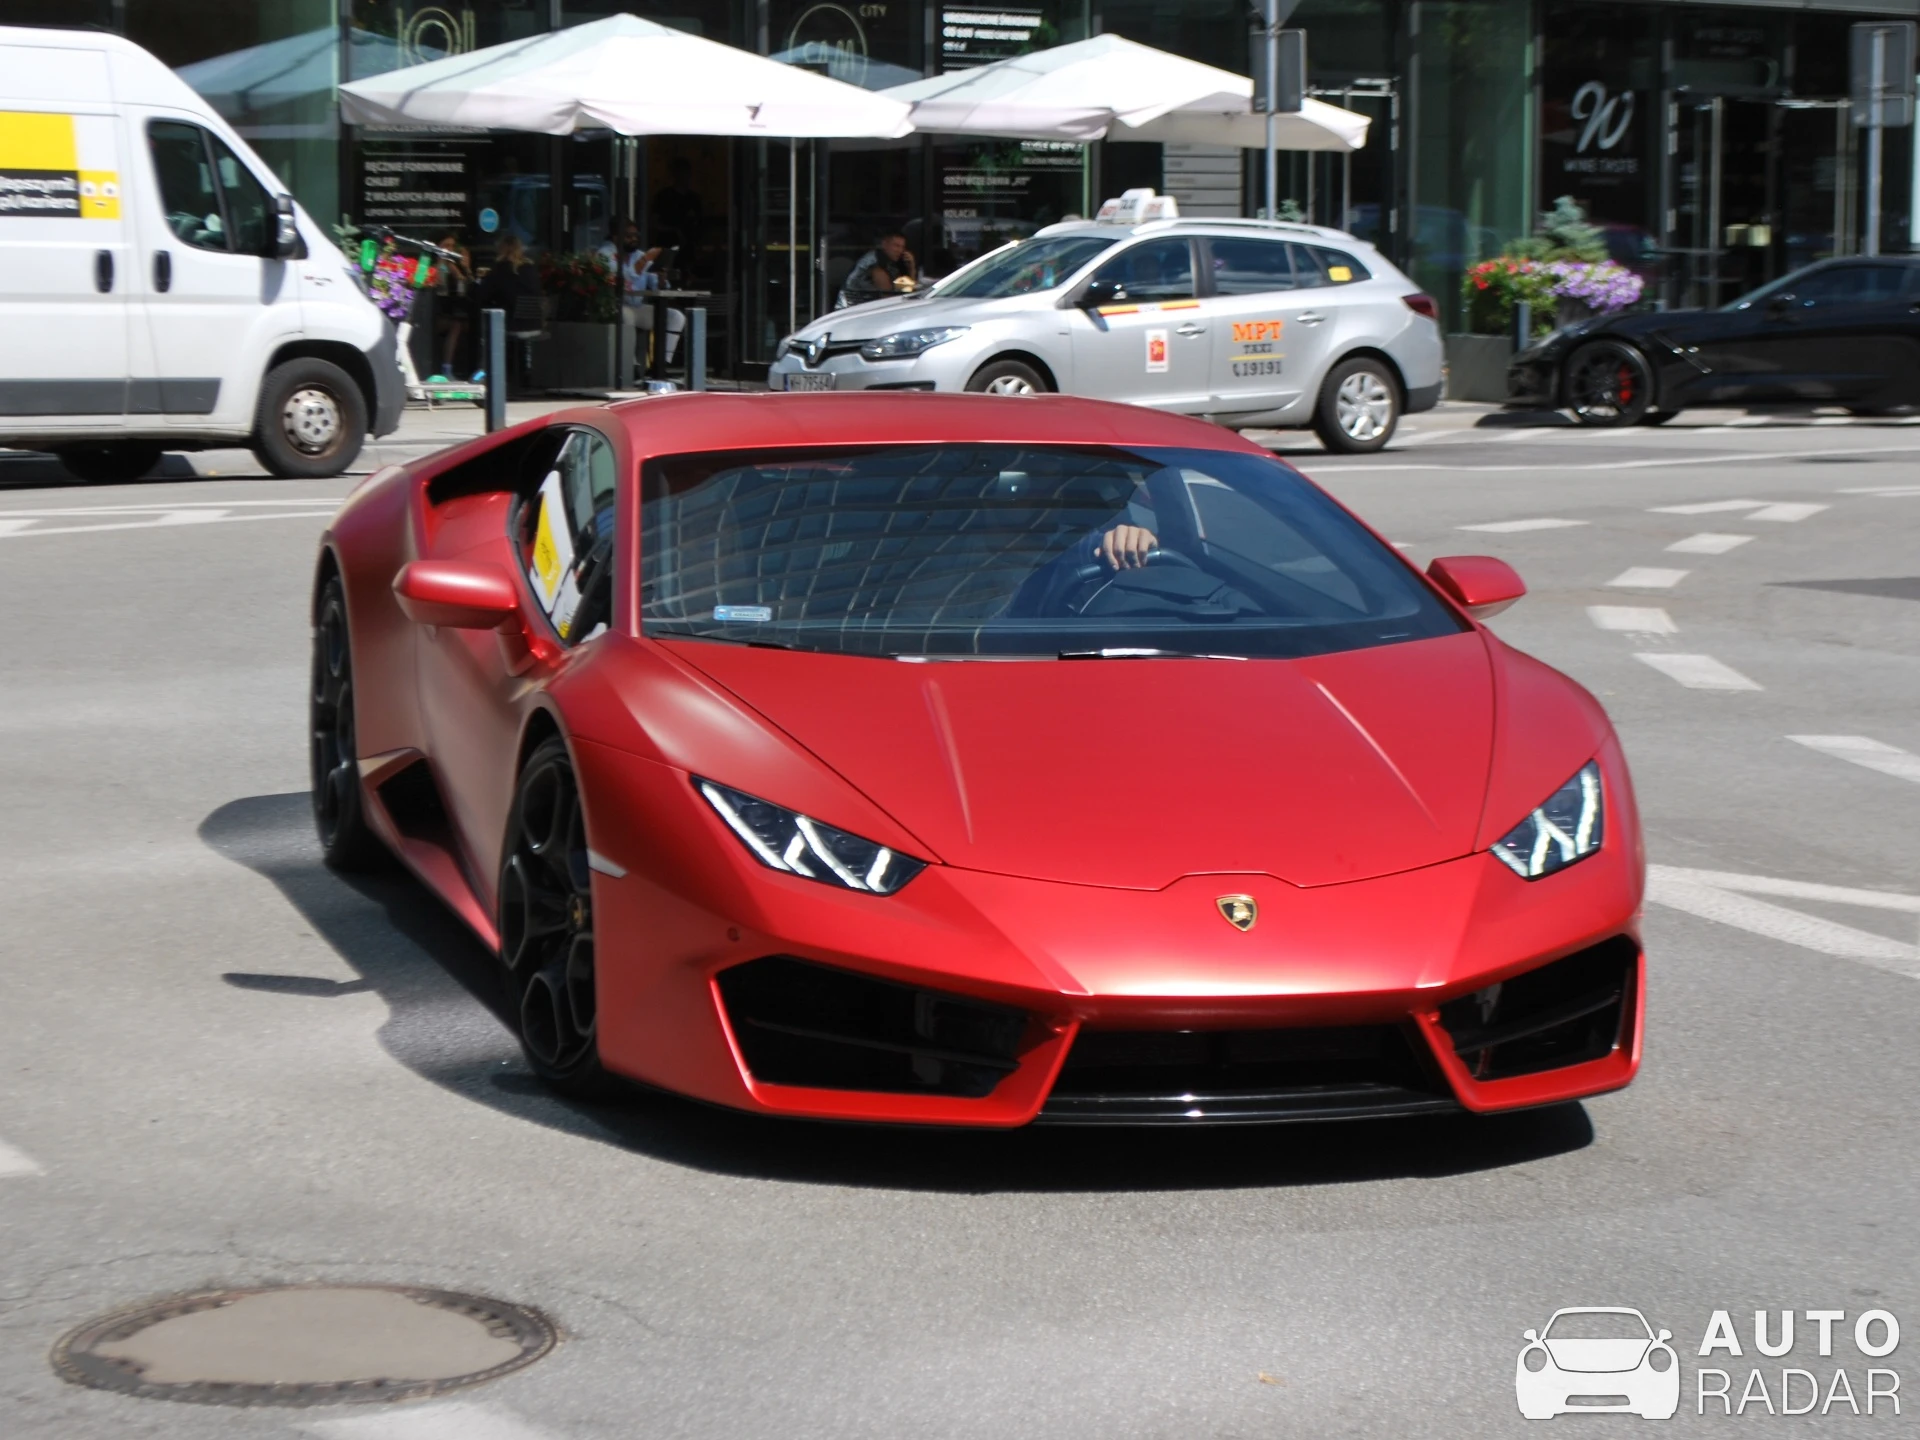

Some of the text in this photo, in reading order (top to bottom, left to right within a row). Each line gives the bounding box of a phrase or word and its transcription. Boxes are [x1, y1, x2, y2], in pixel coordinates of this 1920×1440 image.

[860, 5, 887, 17] CITY
[1563, 159, 1638, 173] WINE TASTE
[1232, 321, 1282, 342] MPT
[1243, 343, 1272, 354] TAXI
[1242, 361, 1281, 377] 19191
